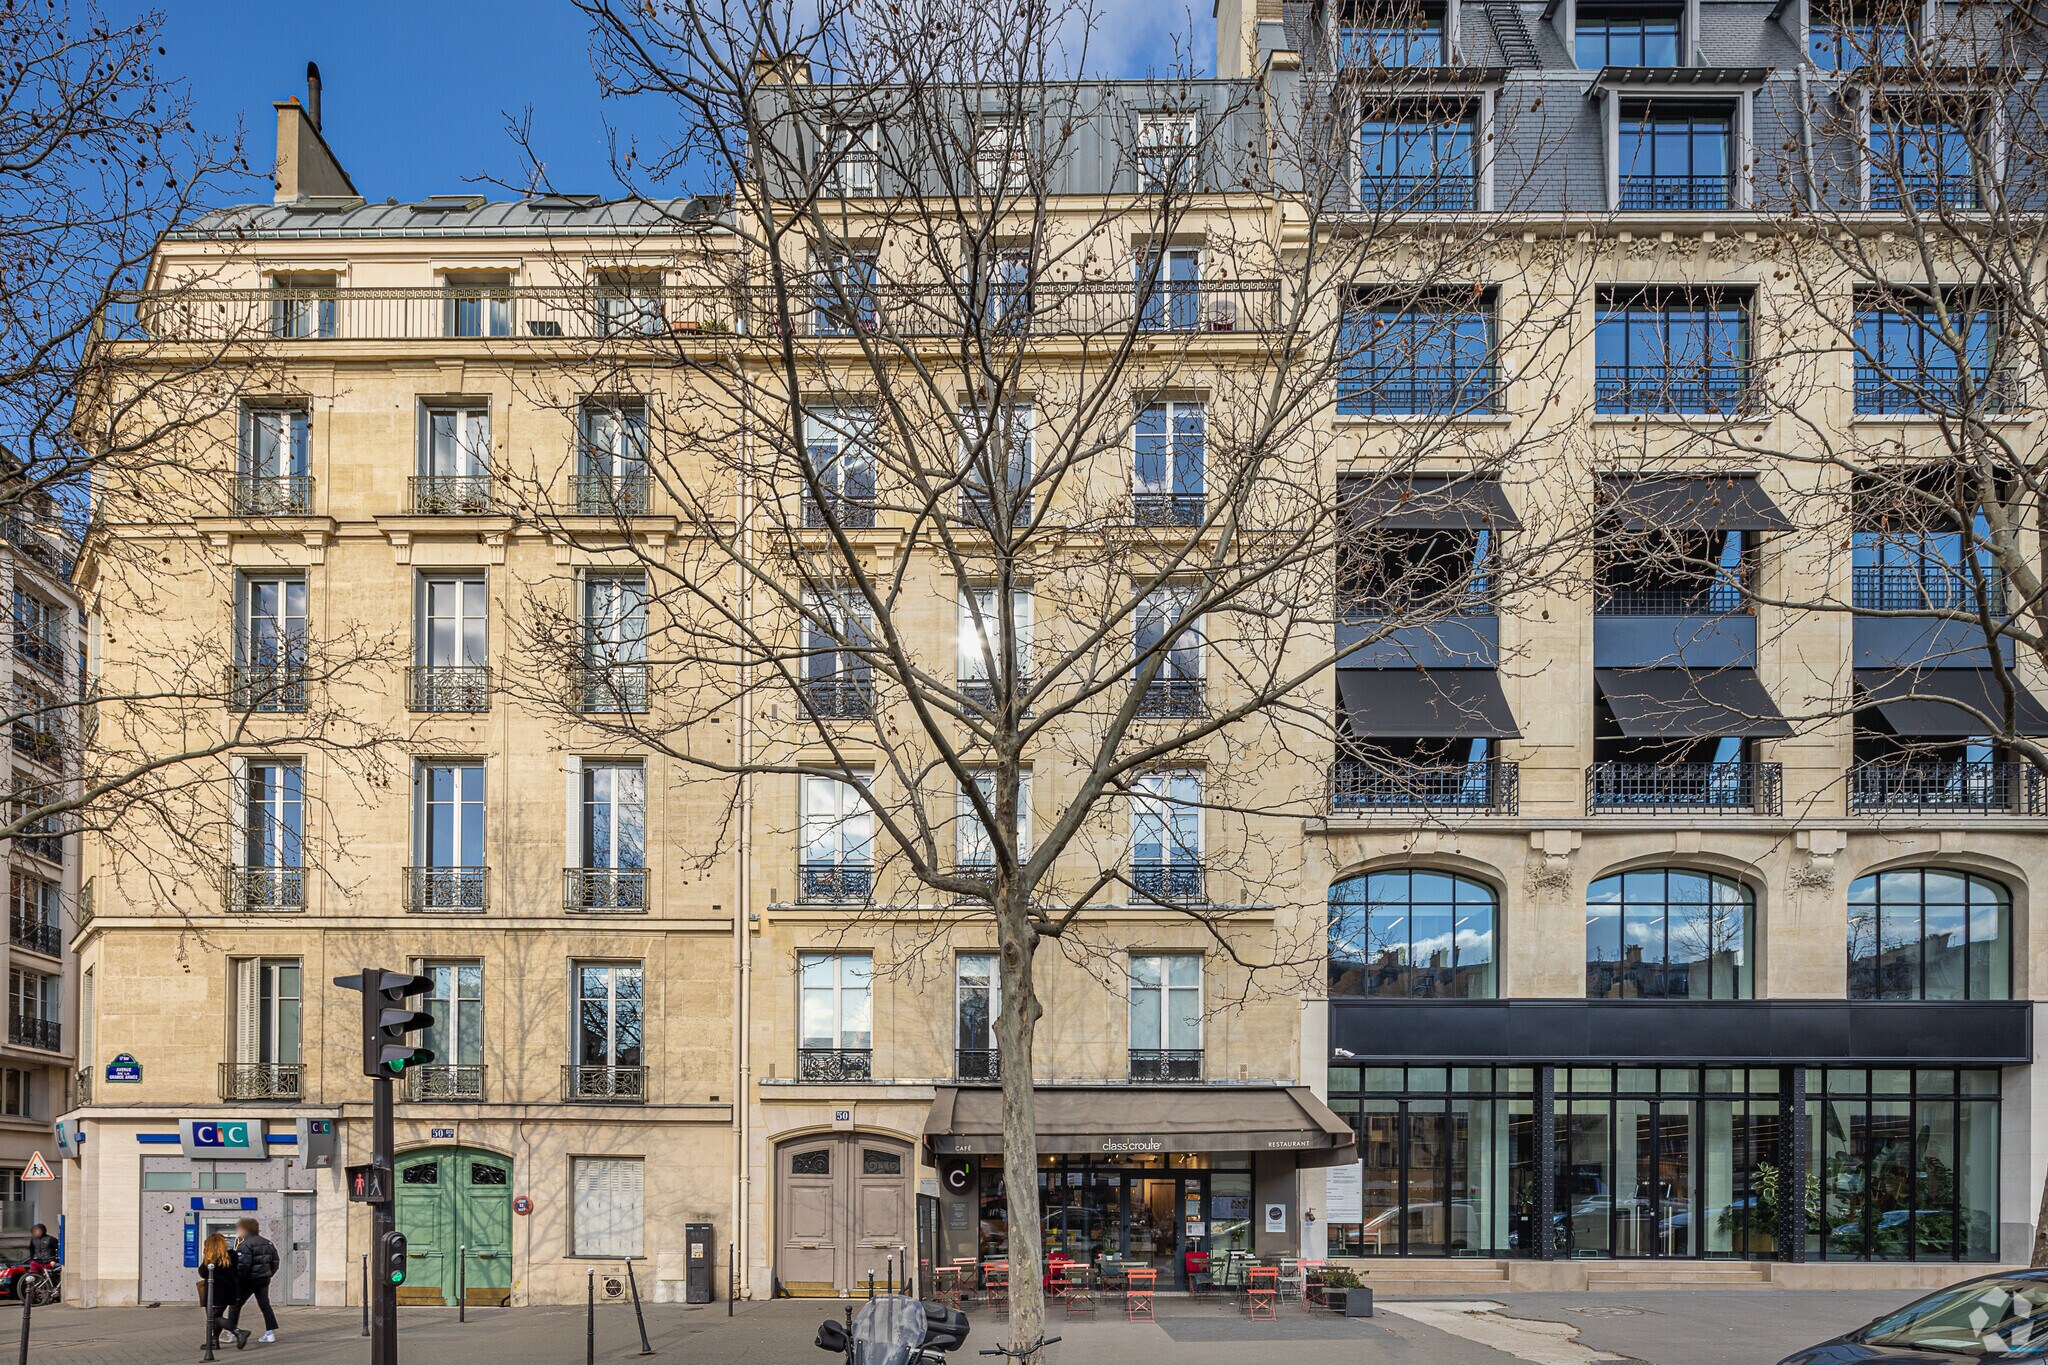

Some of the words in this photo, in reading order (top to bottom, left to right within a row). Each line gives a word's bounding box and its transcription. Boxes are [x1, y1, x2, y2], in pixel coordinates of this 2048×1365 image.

[836, 1111, 848, 1120] 50
[312, 1122, 329, 1132] CIC
[197, 1126, 244, 1143] CIC
[432, 1129, 444, 1138] 50
[1268, 1140, 1310, 1148] RESTAURANT
